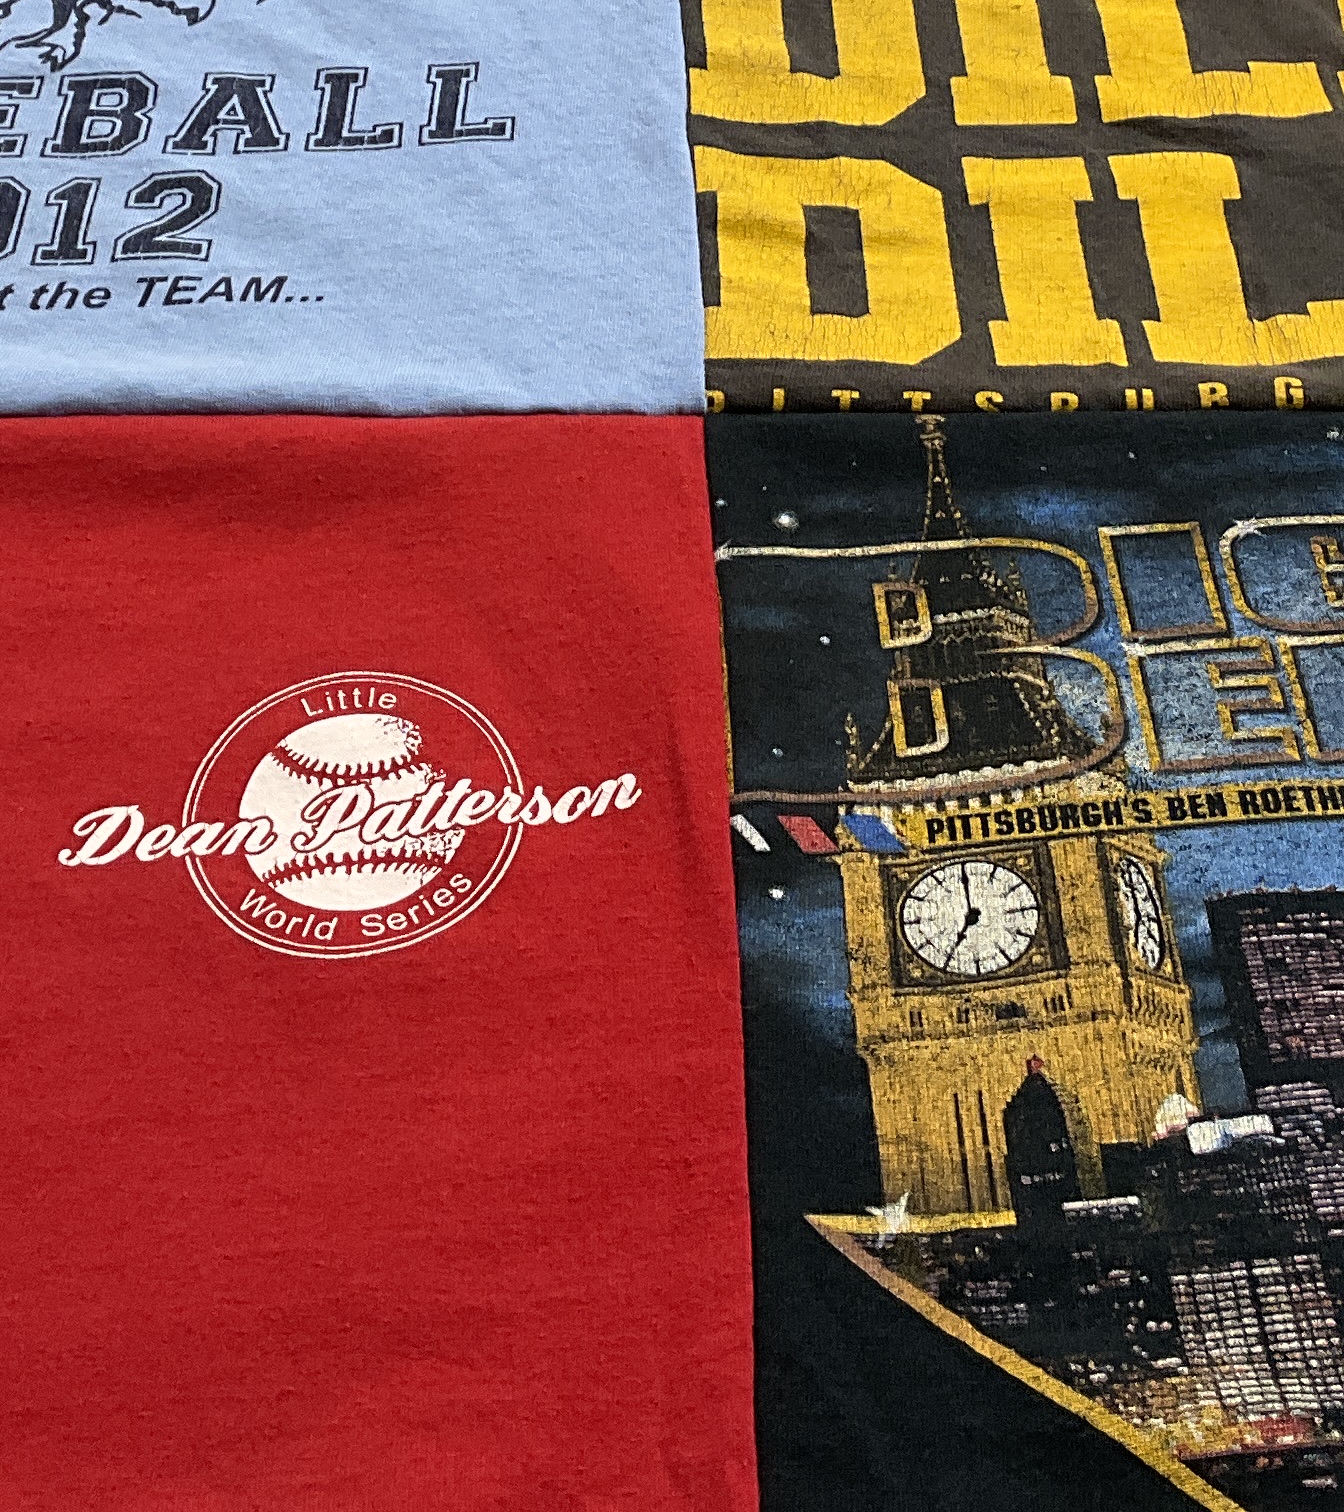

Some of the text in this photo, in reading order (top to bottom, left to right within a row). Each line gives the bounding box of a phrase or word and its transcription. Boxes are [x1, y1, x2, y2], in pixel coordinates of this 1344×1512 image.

[25, 279, 113, 310] the
[135, 274, 326, 309] TEAM...
[300, 687, 398, 718] Little
[58, 772, 643, 868] Dean Patterson
[926, 794, 1154, 846] PITTSBURGH'S
[1166, 791, 1226, 822] BEN
[238, 870, 475, 942] World Series
